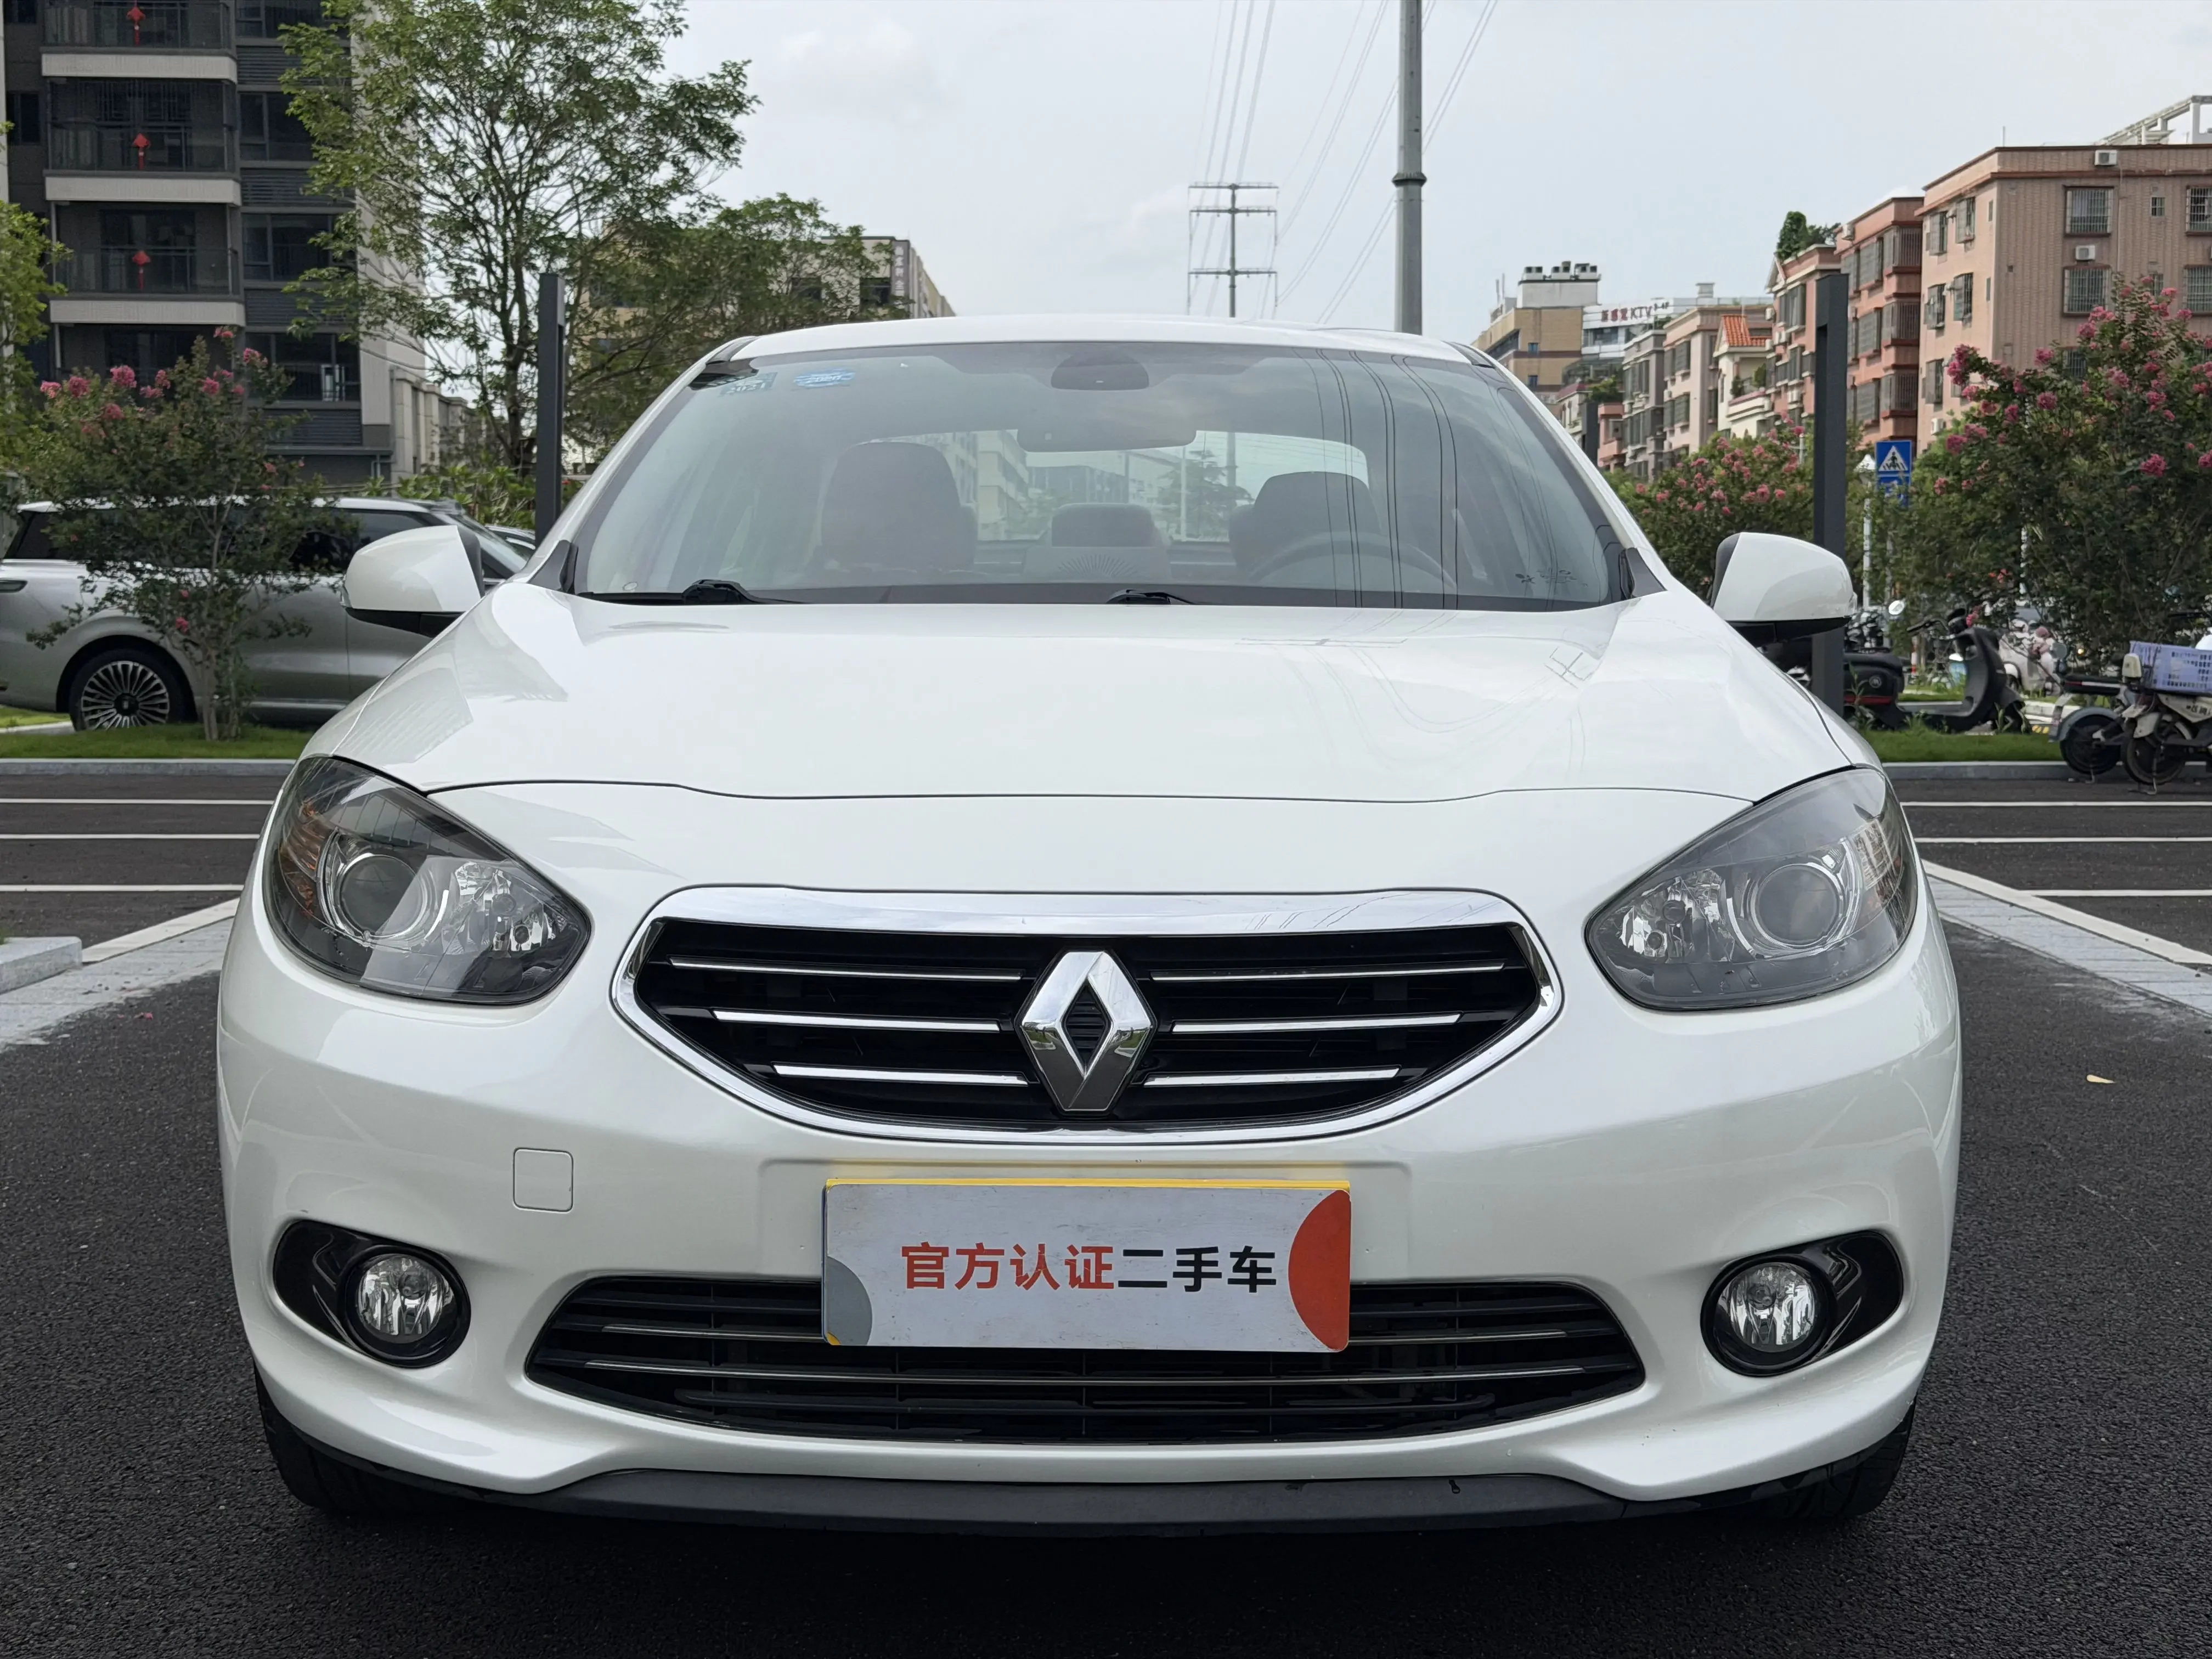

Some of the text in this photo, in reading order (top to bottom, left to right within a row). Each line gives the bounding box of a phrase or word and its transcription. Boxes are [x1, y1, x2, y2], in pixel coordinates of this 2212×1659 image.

[901, 1241, 1277, 1293] 官方认证二手车
